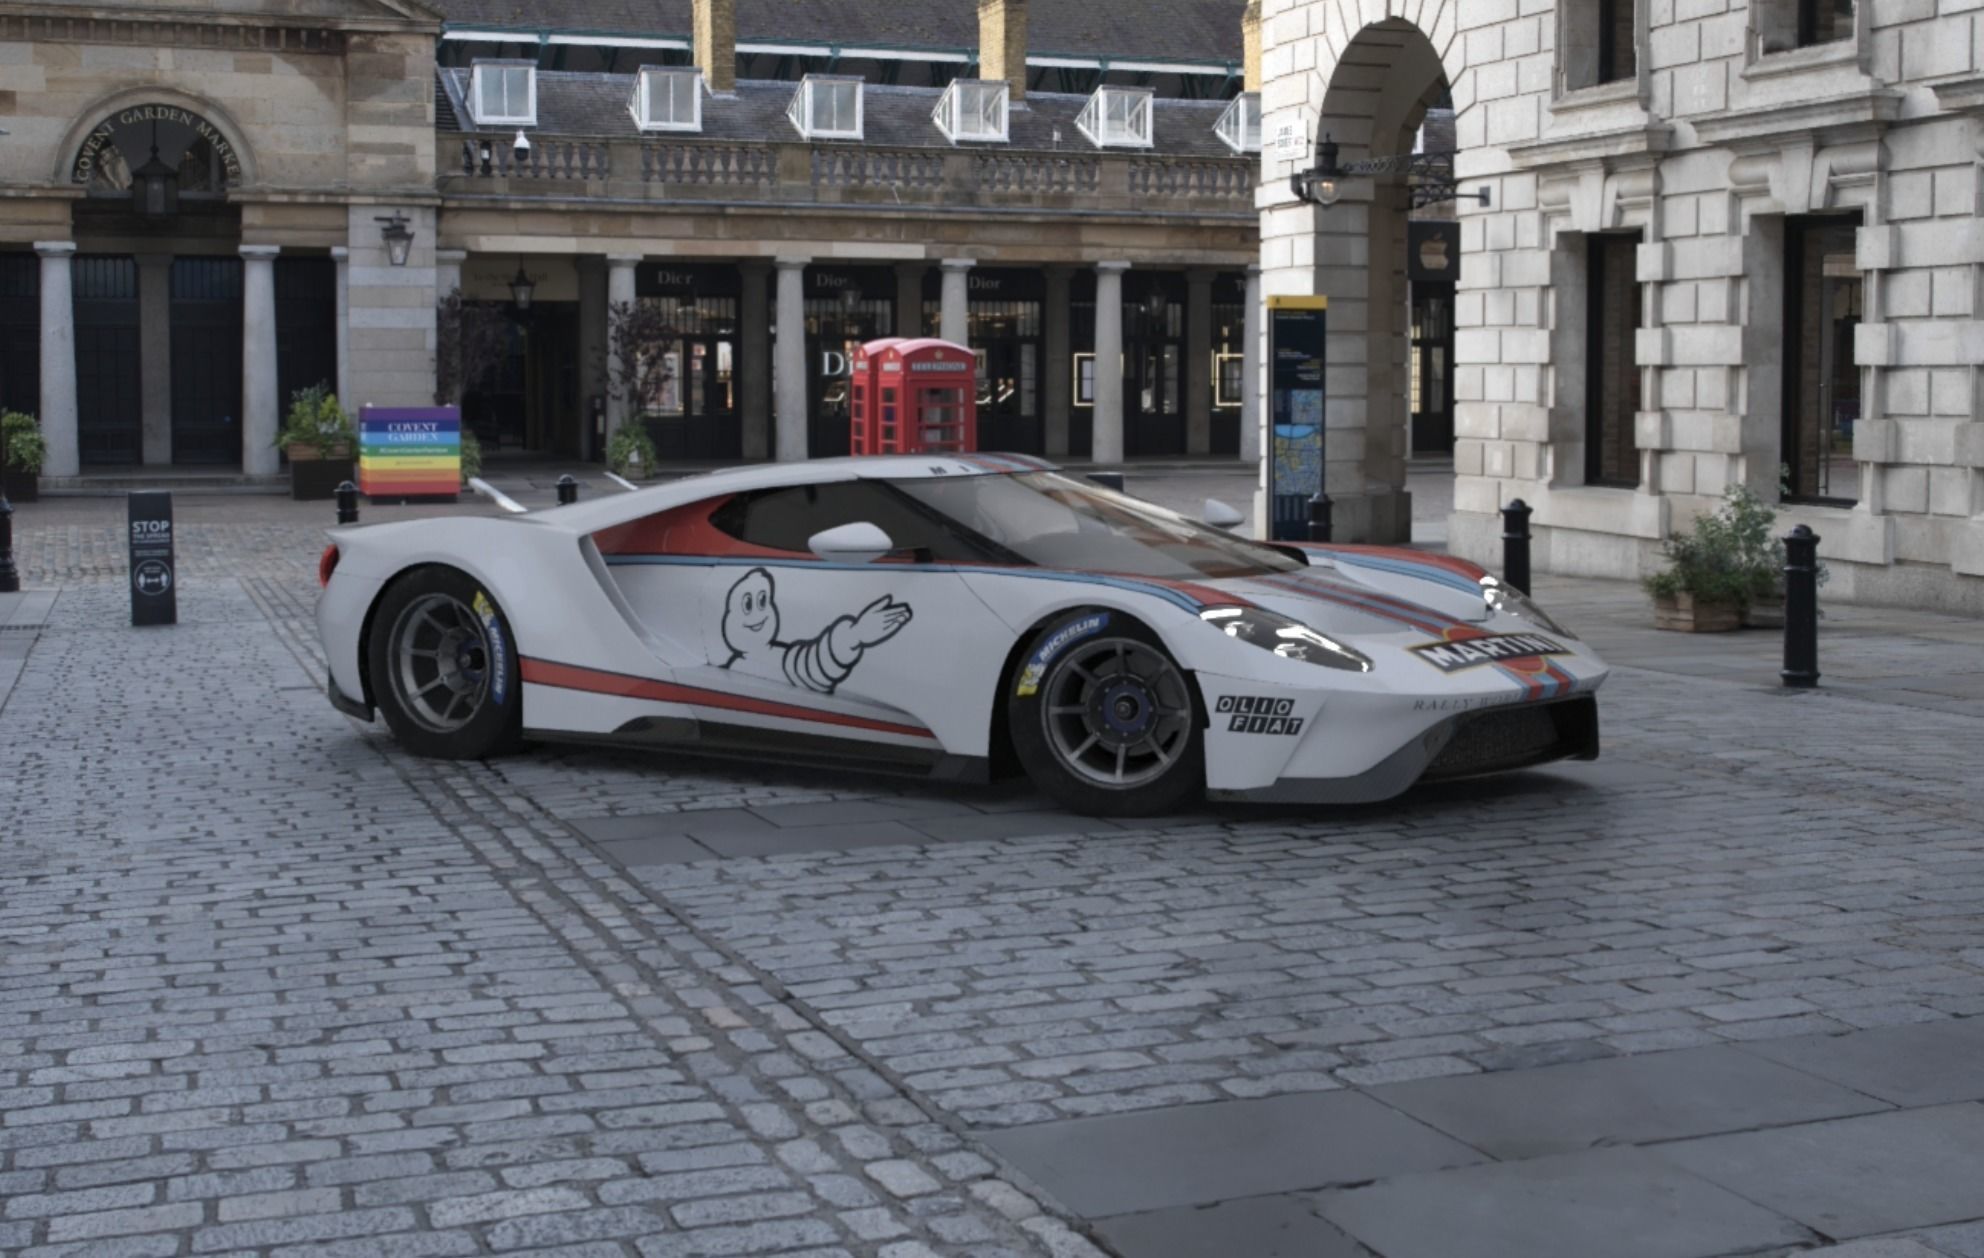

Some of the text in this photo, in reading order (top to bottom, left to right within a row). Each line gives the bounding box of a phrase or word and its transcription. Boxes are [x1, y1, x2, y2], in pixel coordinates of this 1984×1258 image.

[77, 107, 240, 186] COVENT GARDEN MARKET
[968, 276, 1002, 289] Dior
[911, 361, 967, 371] TELEPHONE
[388, 423, 438, 432] COVENT
[388, 432, 438, 441] GARDEN
[132, 521, 169, 532] STOP
[1039, 617, 1100, 661] MICHELIN
[1418, 635, 1563, 667] MARTINI
[489, 627, 504, 694] MICHELIN
[1218, 697, 1291, 714] OLIO
[1413, 698, 1473, 712] RALLY
[1232, 716, 1302, 733] FIAT
